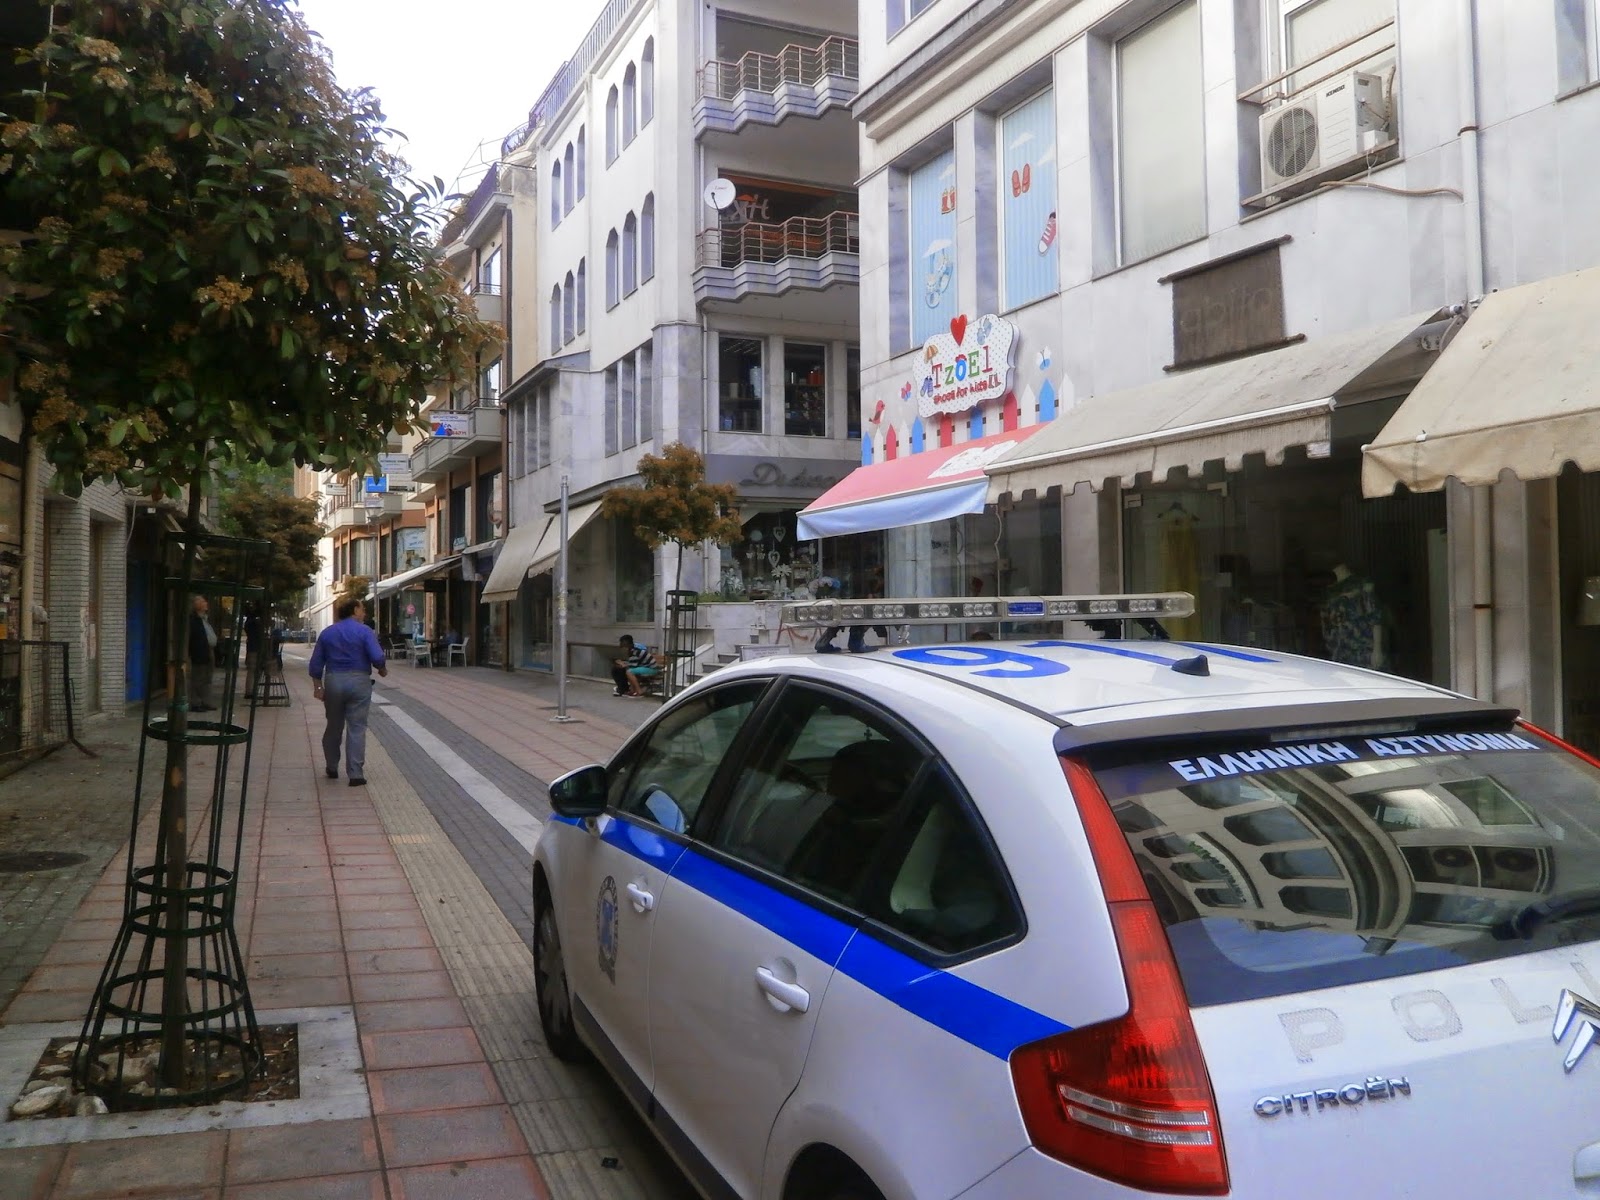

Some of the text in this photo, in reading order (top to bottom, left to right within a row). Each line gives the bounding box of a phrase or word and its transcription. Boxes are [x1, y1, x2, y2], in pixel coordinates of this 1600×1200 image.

[1168, 733, 1540, 781] ΕΛΛΗΝΙΚΗ ΑΣΤΥΝΟΜΙΑ
[1253, 1075, 1412, 1118] CITROËN
